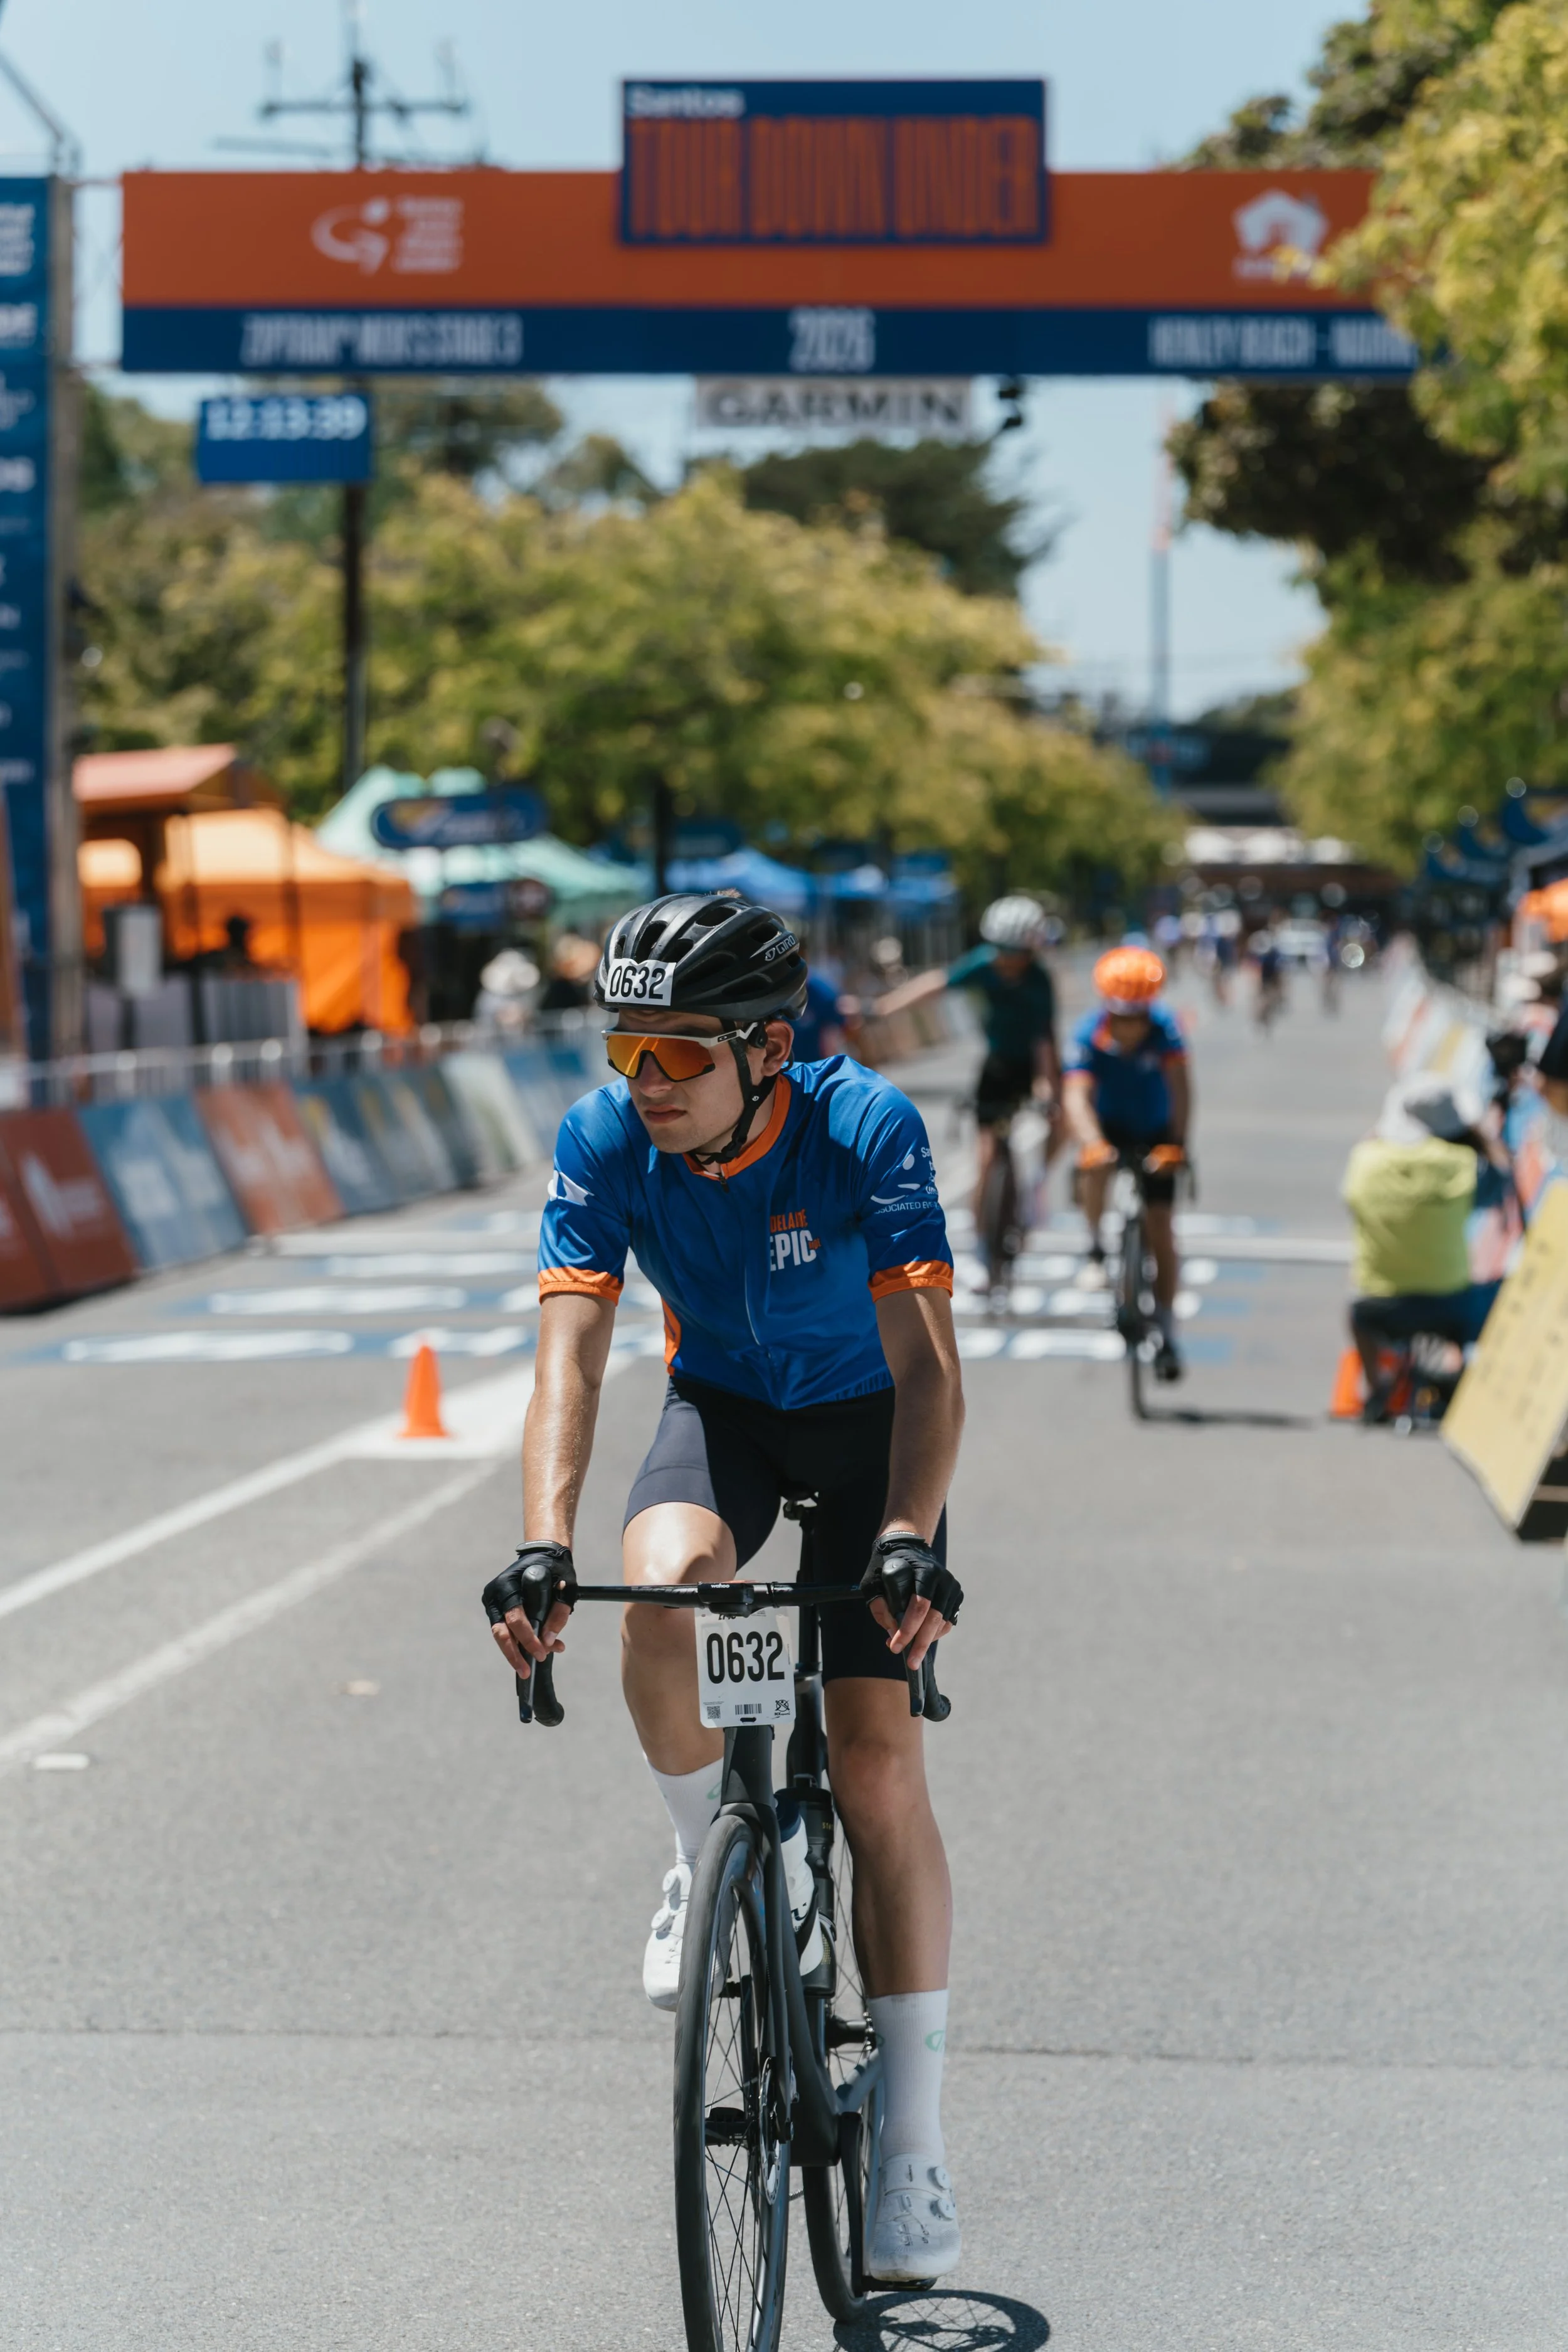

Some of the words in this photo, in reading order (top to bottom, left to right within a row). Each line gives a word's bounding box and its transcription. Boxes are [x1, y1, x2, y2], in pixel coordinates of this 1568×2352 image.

[706, 385, 963, 426] GARMIN
[775, 935, 796, 954] GIRO
[609, 965, 666, 1000] 0632
[770, 1230, 817, 1272] EPIC
[706, 1631, 785, 1684] 0632
